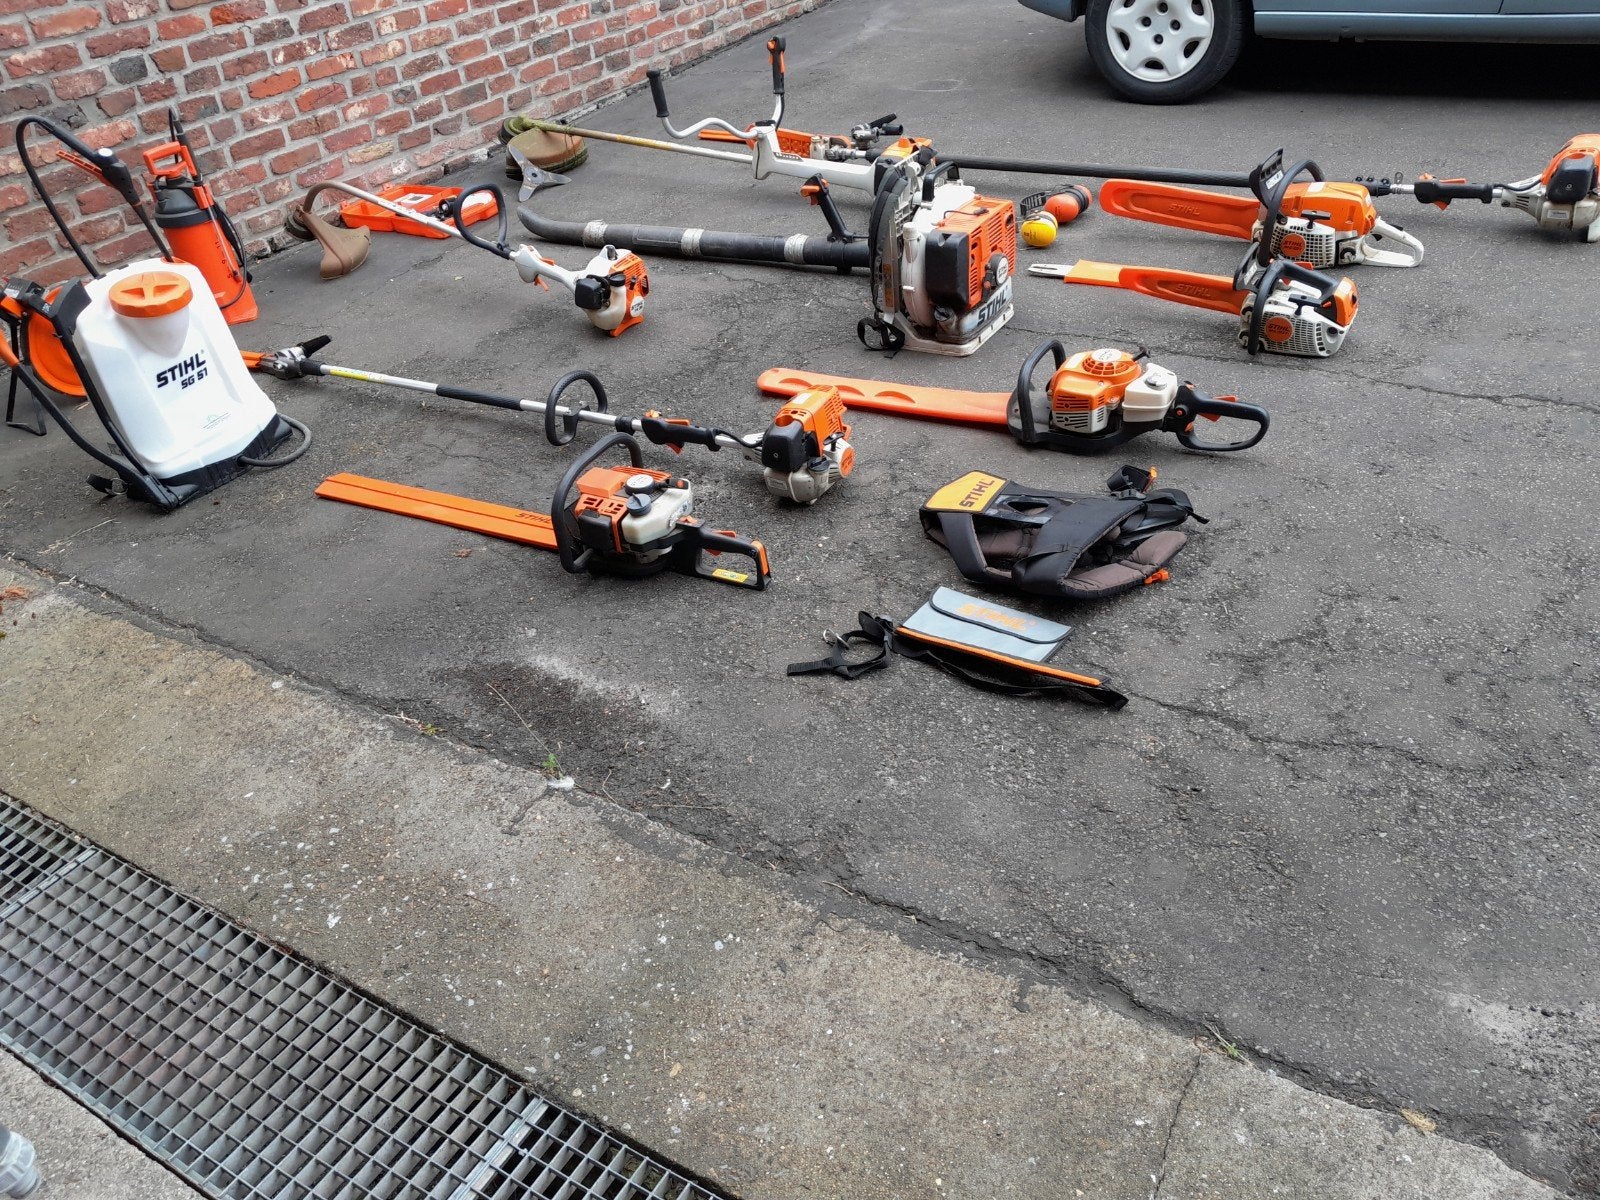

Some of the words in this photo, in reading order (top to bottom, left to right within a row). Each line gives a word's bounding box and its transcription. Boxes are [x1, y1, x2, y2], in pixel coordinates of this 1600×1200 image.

[1175, 283, 1211, 297] STIHL
[977, 289, 1006, 326] STIHL
[156, 353, 206, 388] STIHL
[181, 375, 195, 390] SG
[197, 367, 208, 381] 51
[959, 480, 995, 507] STIHL
